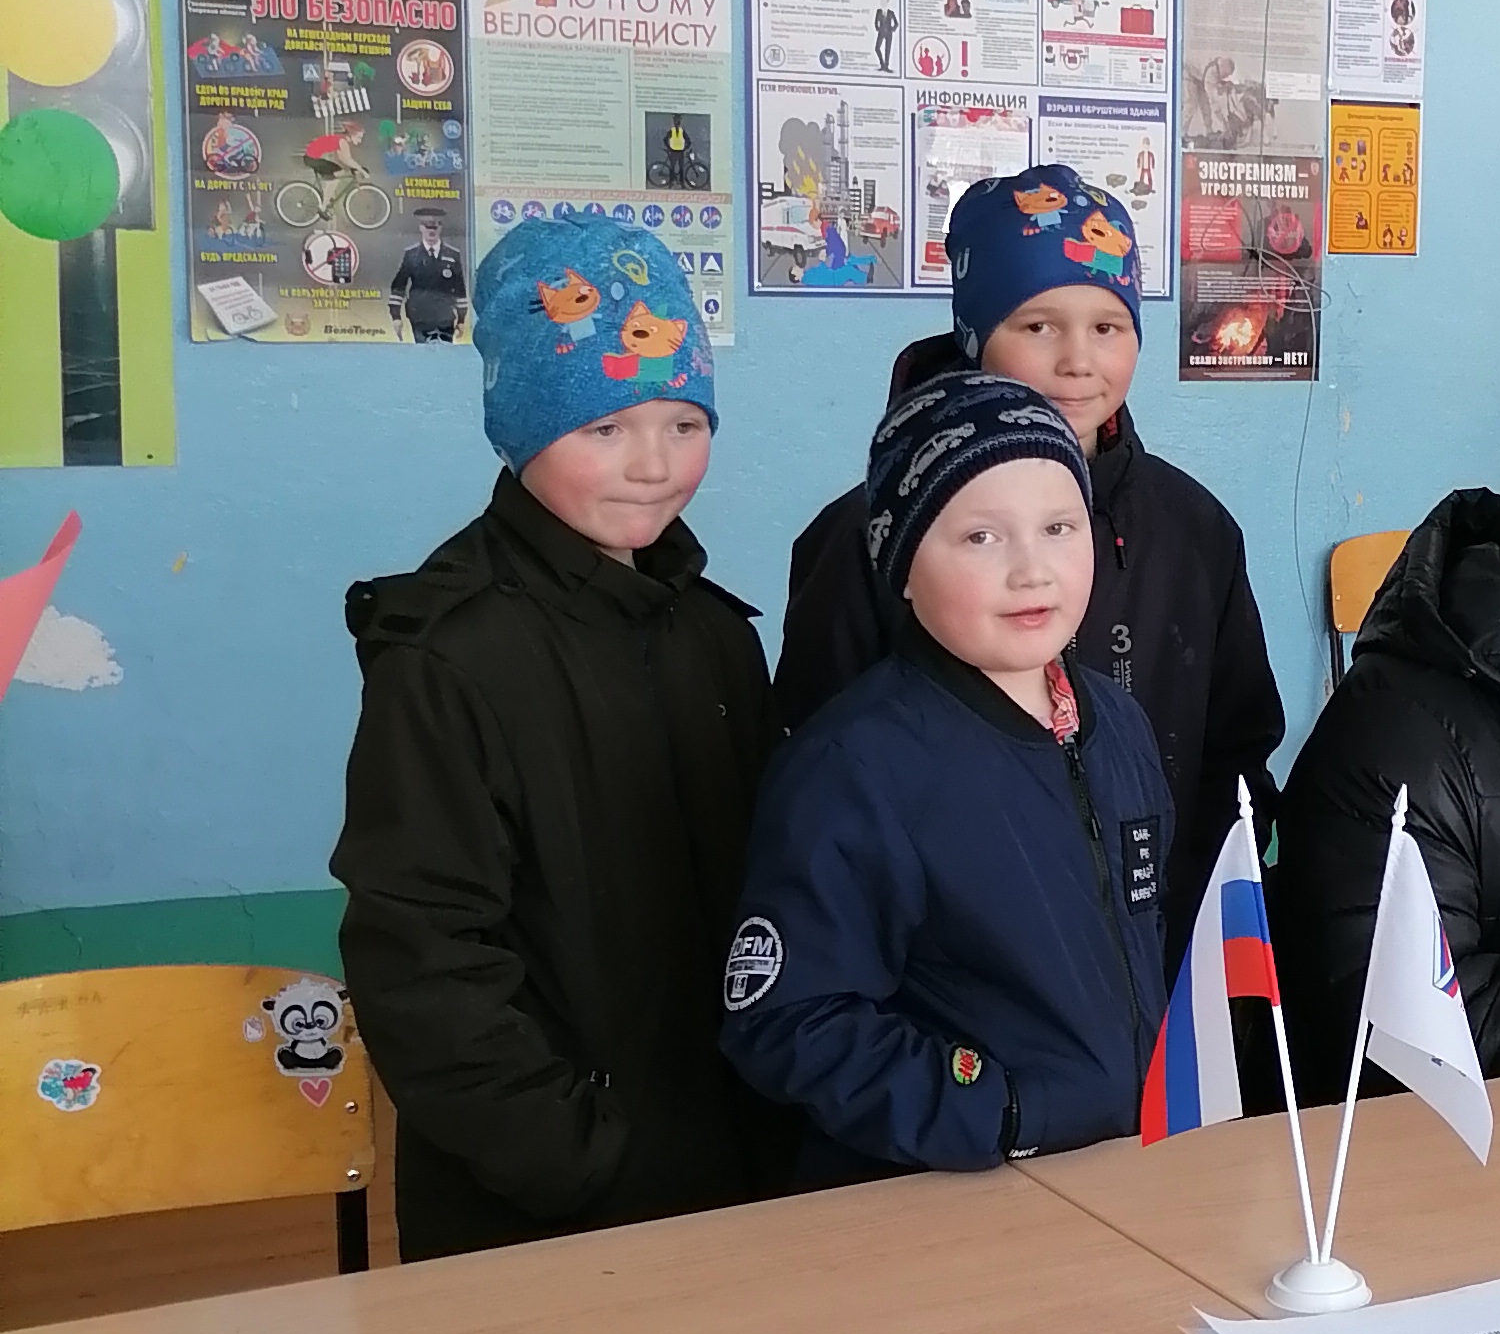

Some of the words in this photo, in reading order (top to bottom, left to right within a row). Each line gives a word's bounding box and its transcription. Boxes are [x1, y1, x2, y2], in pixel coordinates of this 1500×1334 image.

[483, 11, 717, 48] ВЕЛОСИПЕДИСТУ
[917, 90, 1027, 109] ИНФОРМАЦИЯ
[1046, 103, 1073, 113] ВЗРЫВ
[1199, 161, 1296, 182] ЭКСТРЕМИЗМ
[1200, 182, 1242, 196] УГРОЗА
[1245, 183, 1309, 199] ОБЩЕСТВУ!
[1283, 352, 1308, 366] НЕТ!
[1111, 624, 1132, 653] 3
